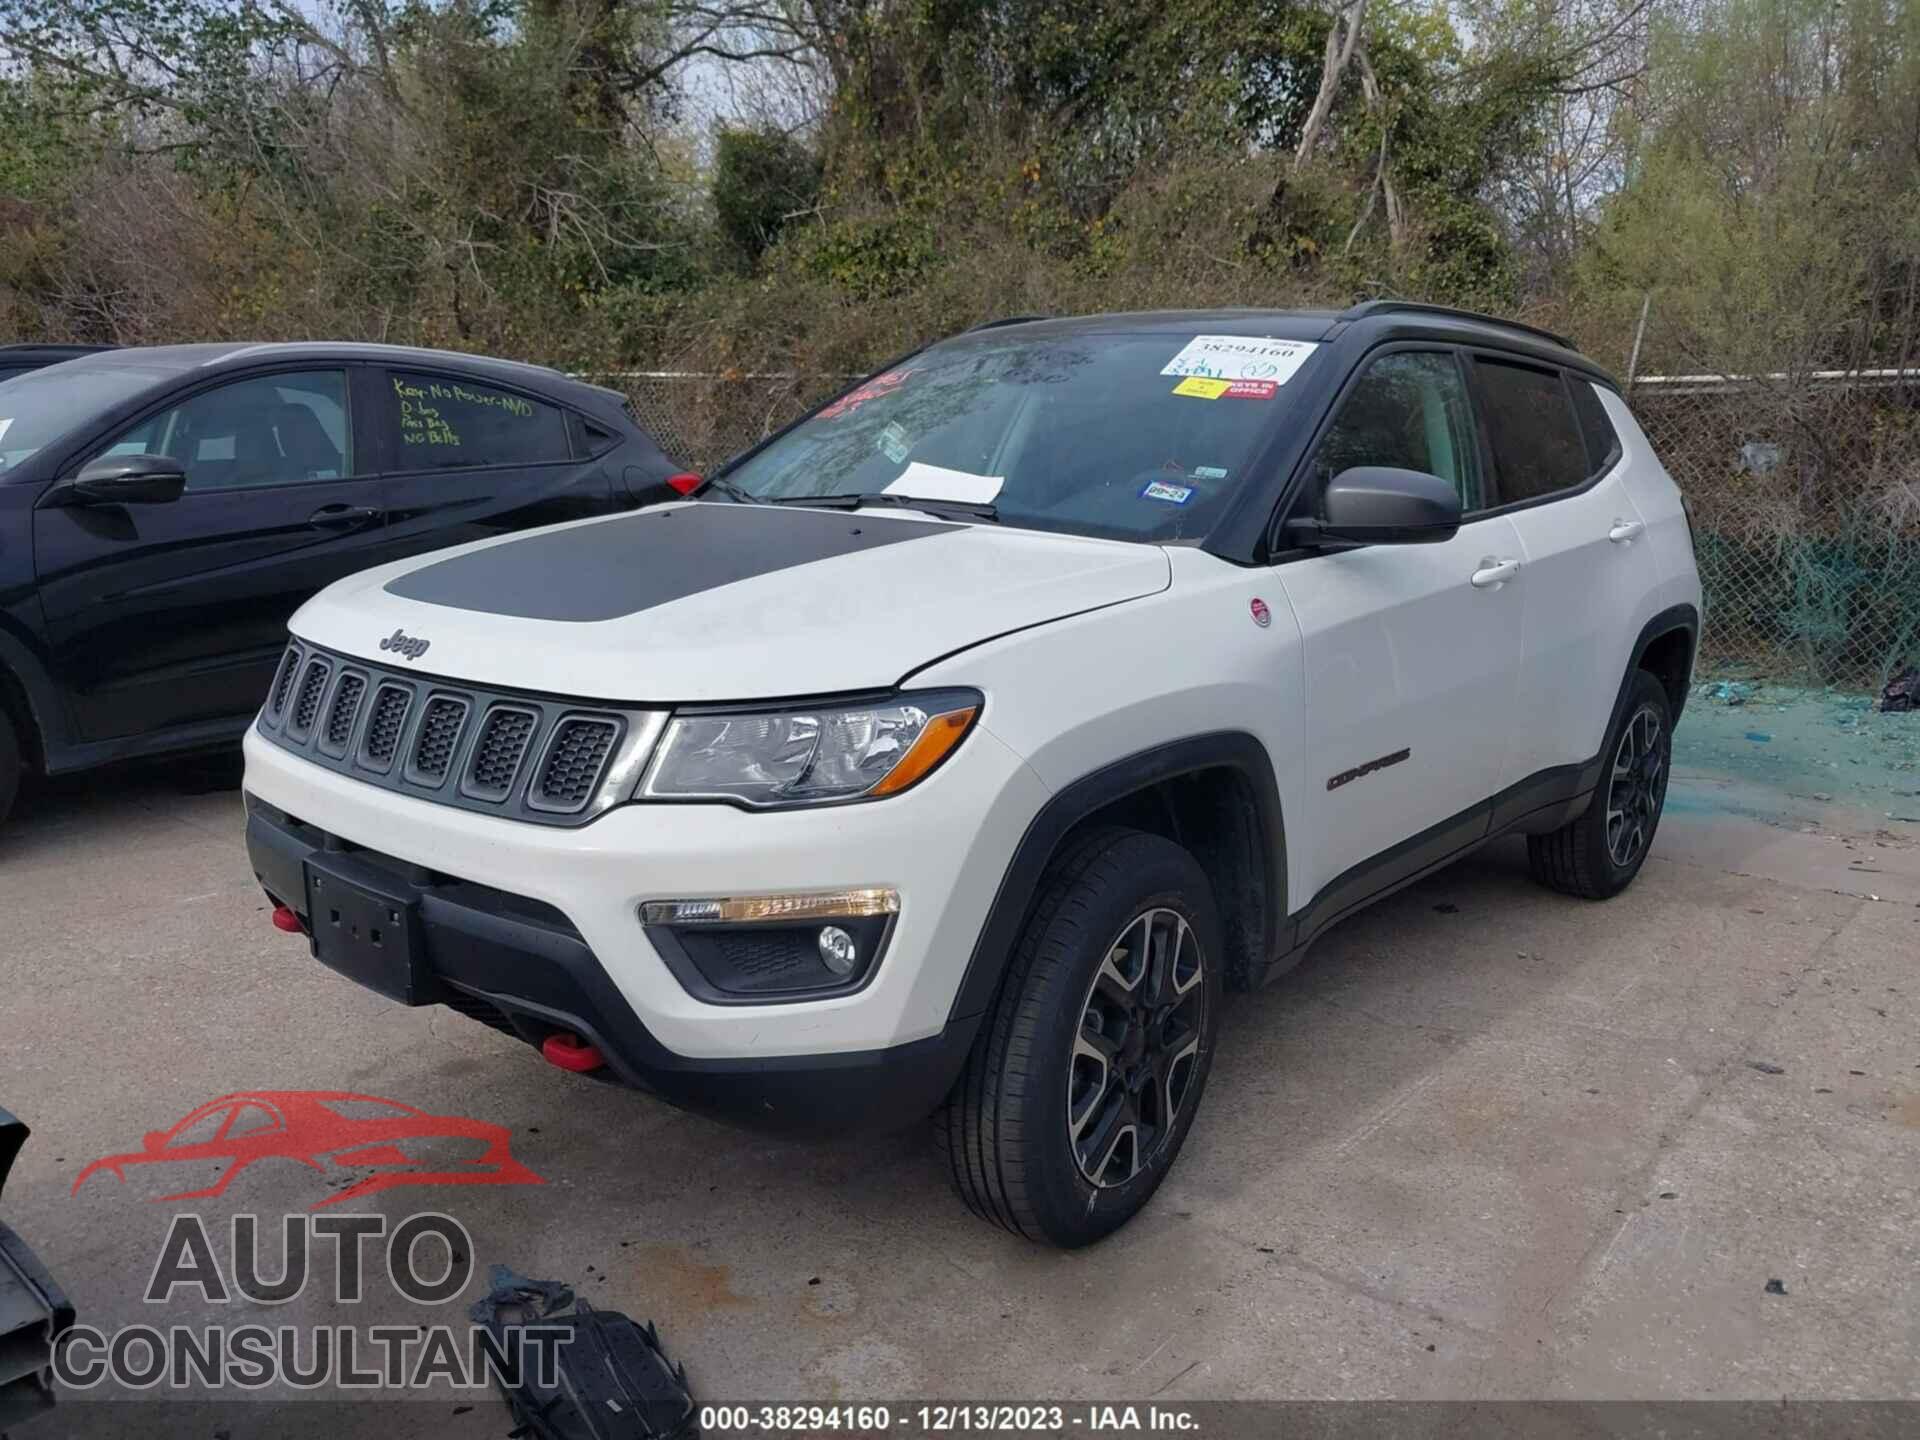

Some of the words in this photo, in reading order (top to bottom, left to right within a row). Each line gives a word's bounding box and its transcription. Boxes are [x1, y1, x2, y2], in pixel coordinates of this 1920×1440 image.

[1230, 387, 1270, 395] OFFICE
[379, 628, 431, 661] Jeep
[1326, 747, 1411, 792] COMP
